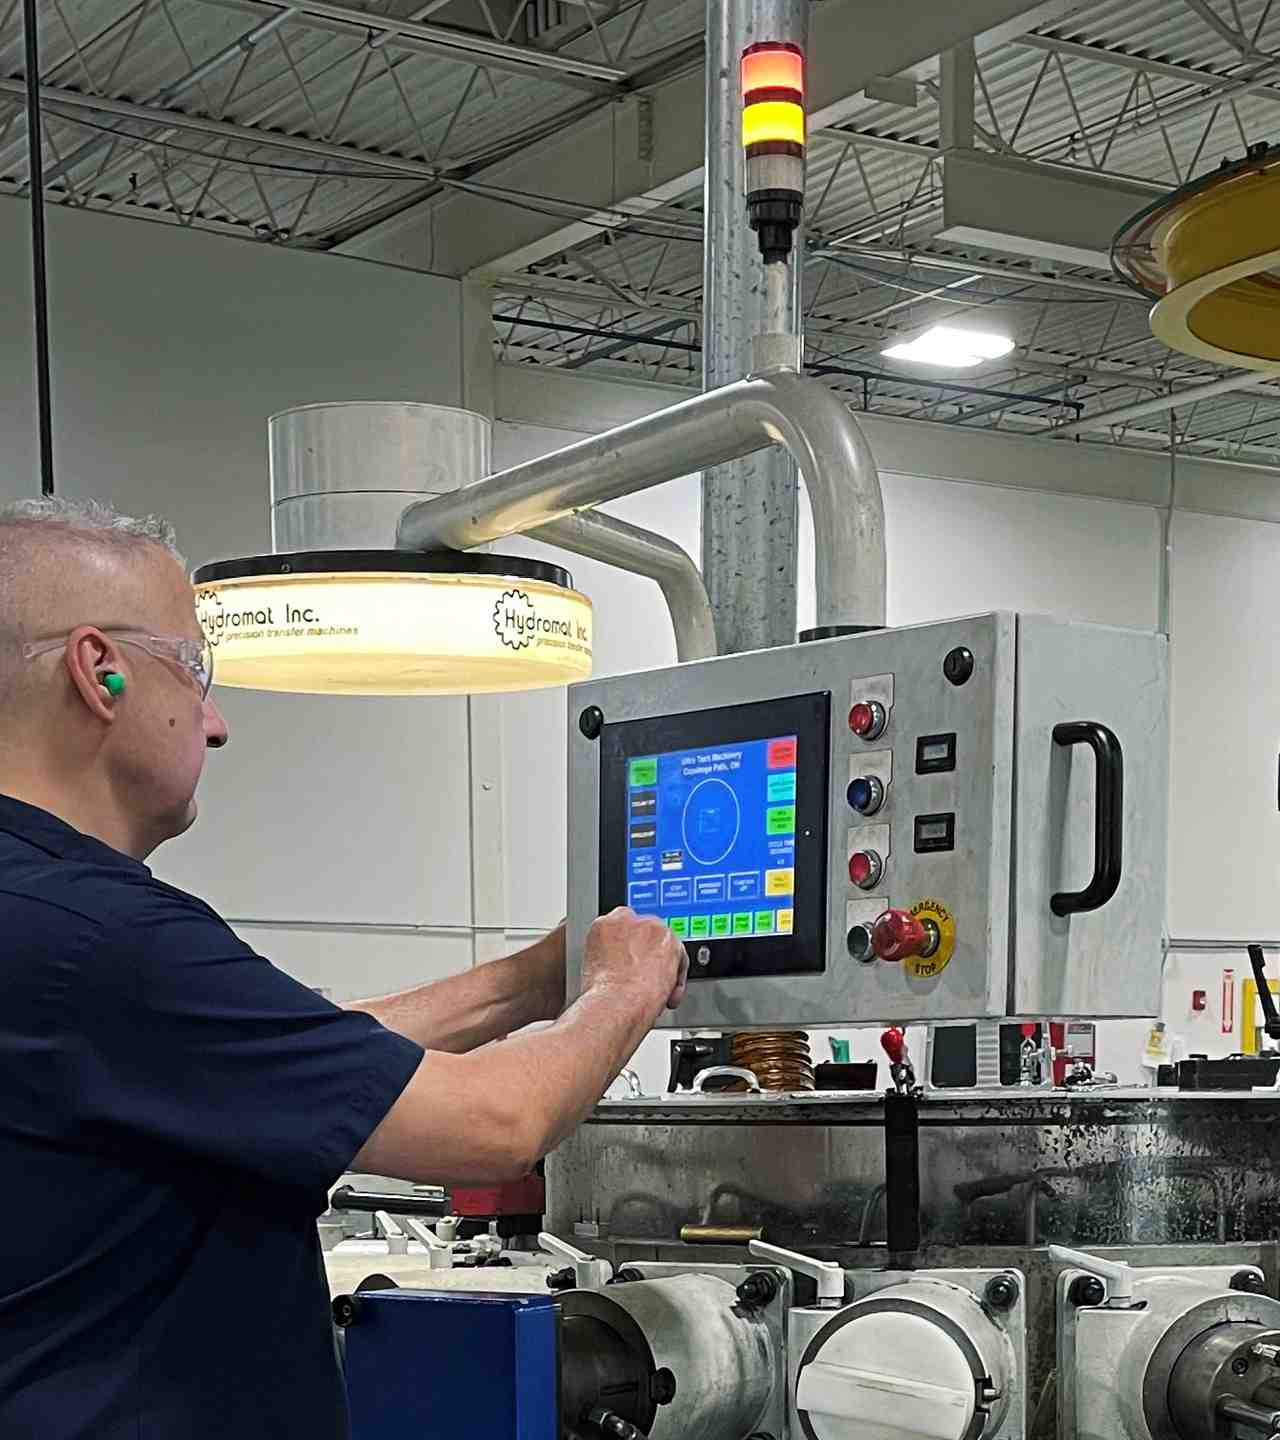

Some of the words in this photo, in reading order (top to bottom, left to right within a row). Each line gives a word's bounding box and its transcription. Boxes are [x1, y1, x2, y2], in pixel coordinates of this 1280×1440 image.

[286, 603, 320, 623] Inc.
[505, 607, 572, 638] Hydromat
[226, 629, 265, 643] precision
[267, 625, 305, 637] transfer
[307, 625, 359, 636] machines
[915, 962, 937, 975] STOP
